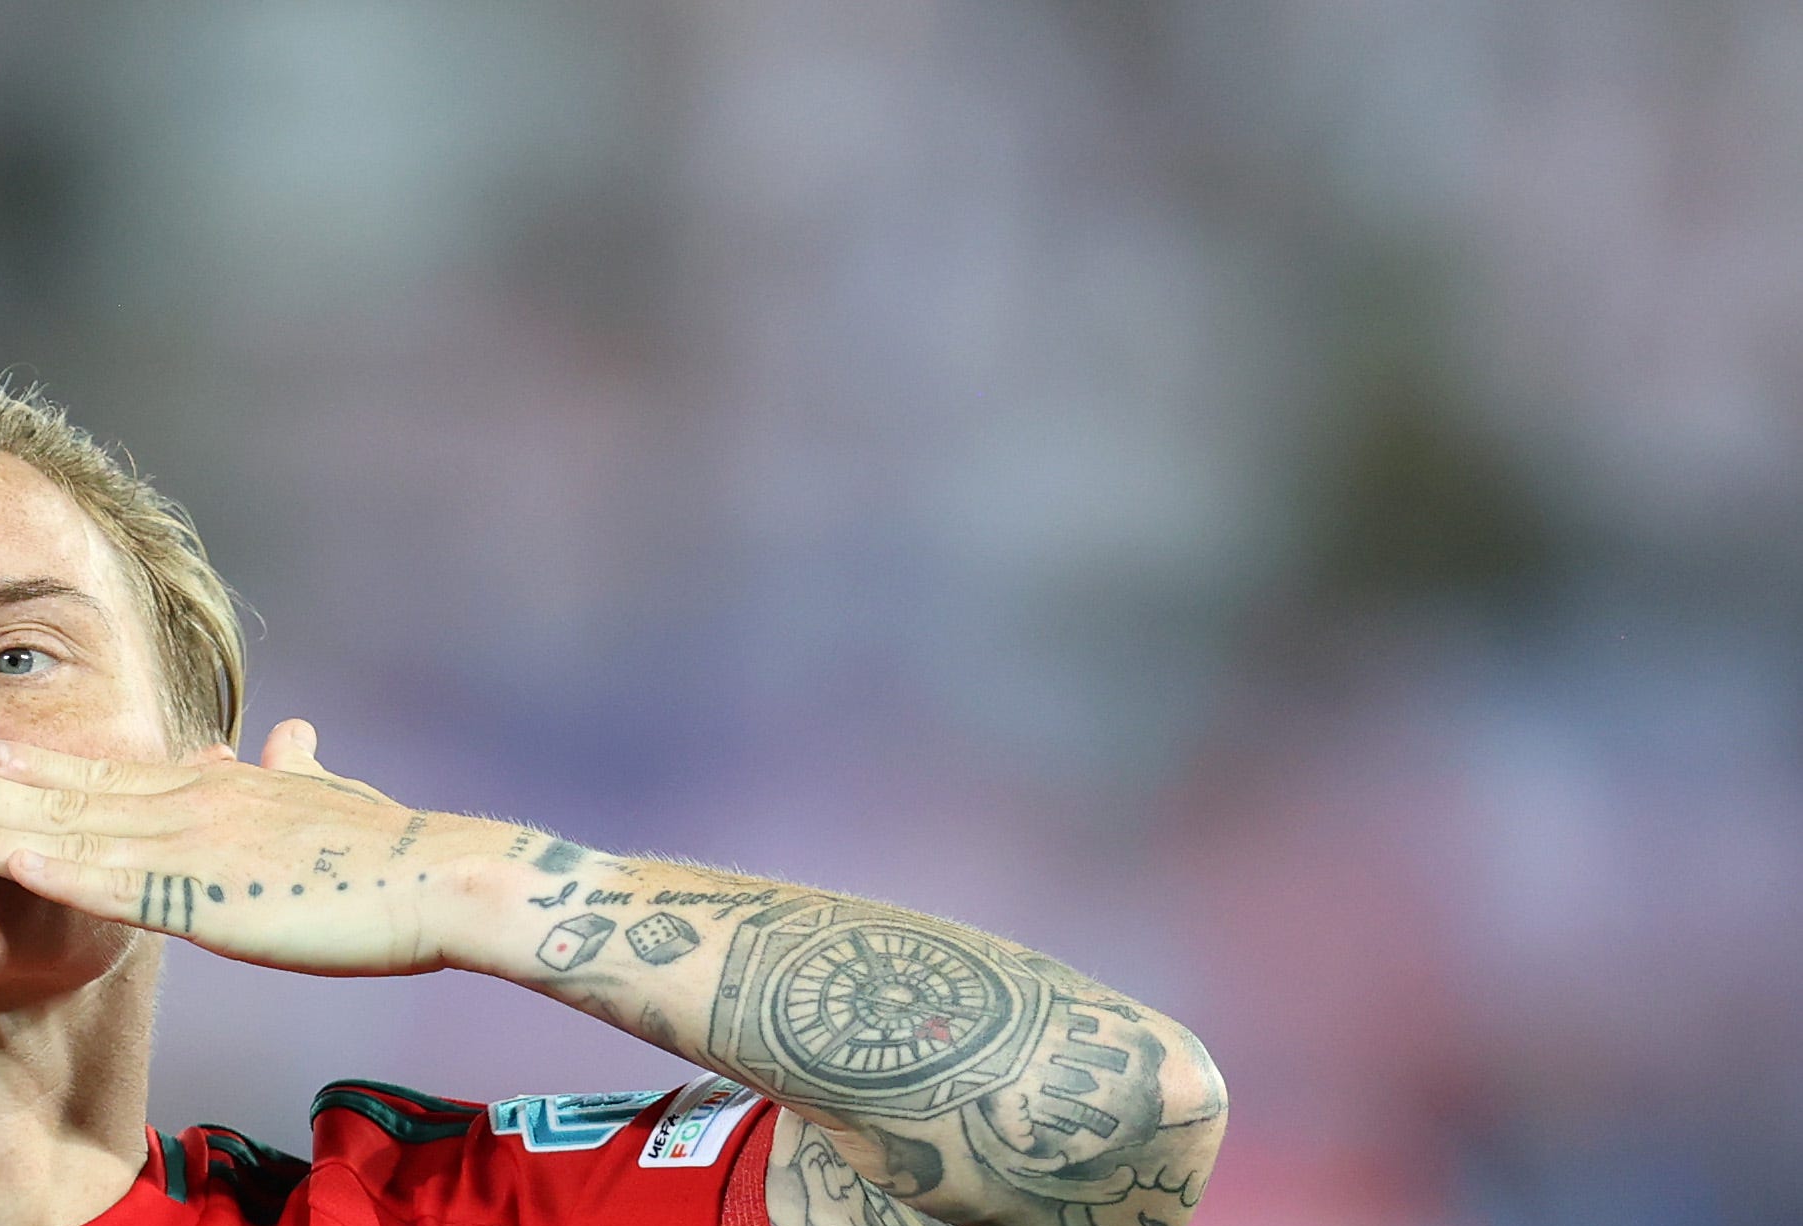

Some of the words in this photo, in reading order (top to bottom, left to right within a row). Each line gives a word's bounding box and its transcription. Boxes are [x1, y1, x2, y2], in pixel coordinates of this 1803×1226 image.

[528, 881, 578, 909] I
[585, 888, 634, 905] am
[647, 888, 778, 920] enough
[648, 1113, 680, 1159] UEFA
